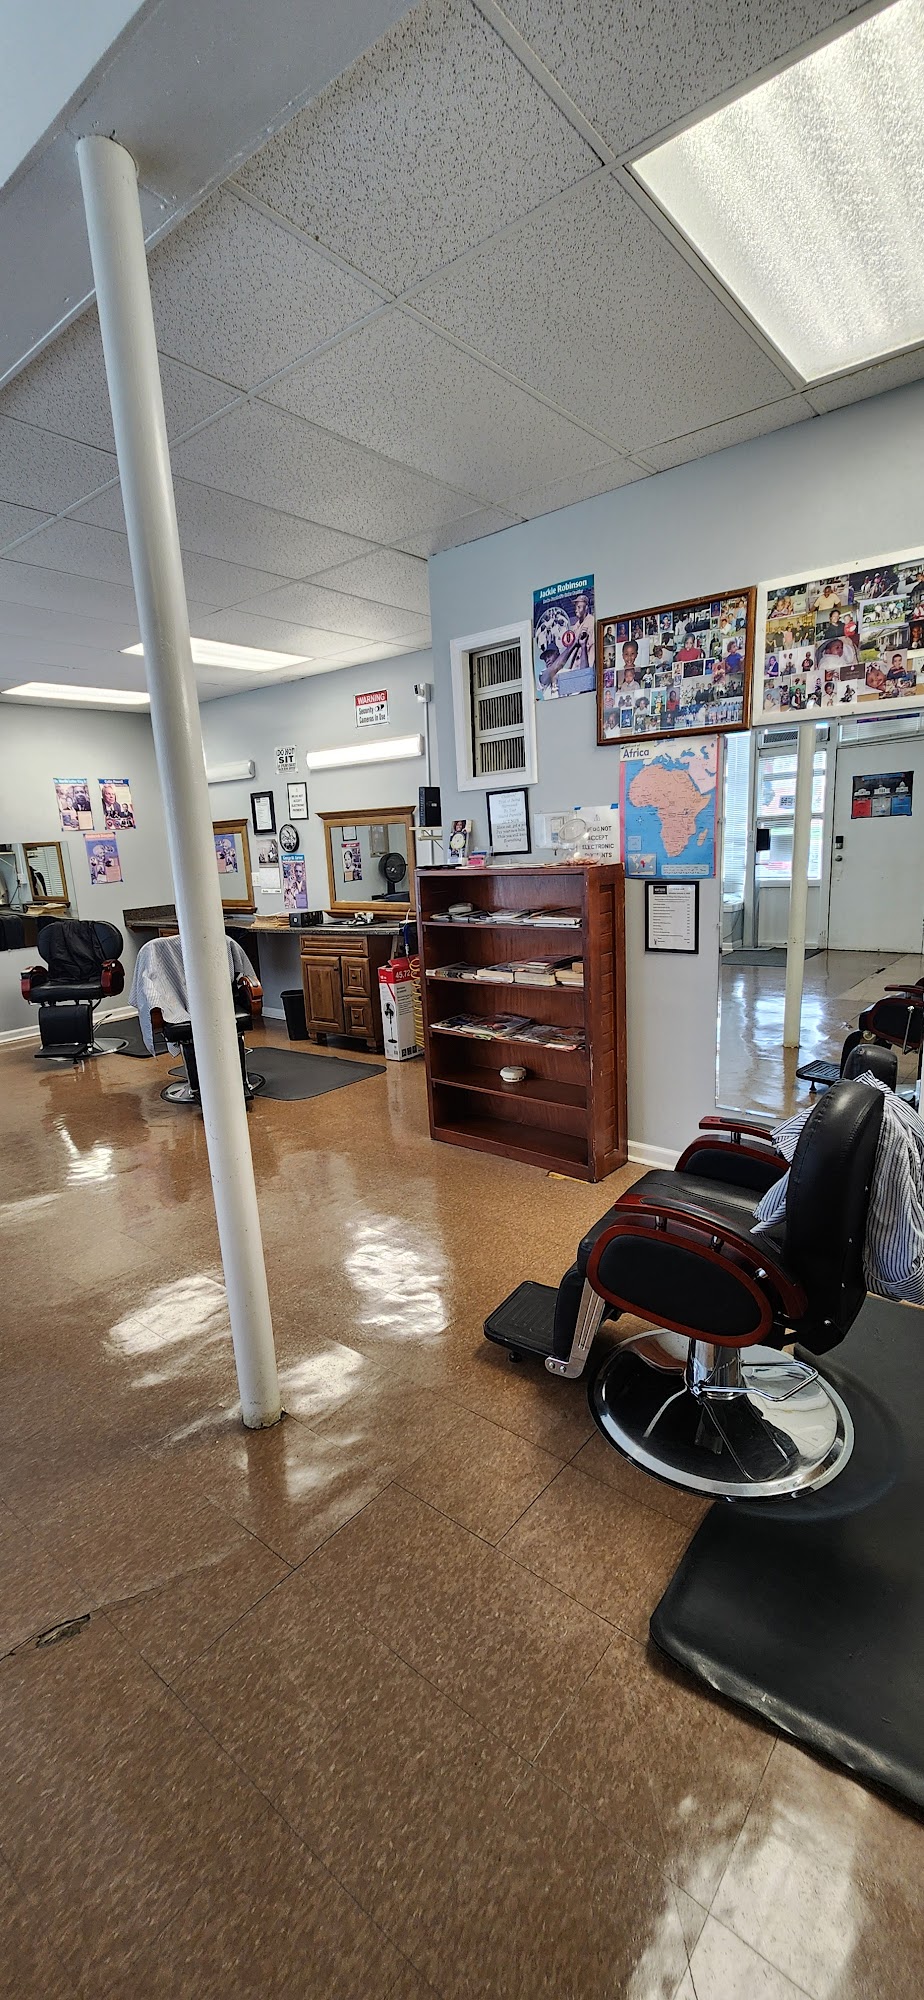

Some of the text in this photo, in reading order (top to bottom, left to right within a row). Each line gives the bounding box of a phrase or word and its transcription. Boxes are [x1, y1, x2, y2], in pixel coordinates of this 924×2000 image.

[540, 587, 556, 599] Jackie
[557, 579, 588, 593] Robinson
[357, 693, 385, 705] WARNING
[359, 707, 374, 715] Security
[359, 716, 375, 724] Cameras
[276, 747, 295, 757] DO NOT
[623, 747, 650, 759] Africa
[278, 755, 294, 764] SIT
